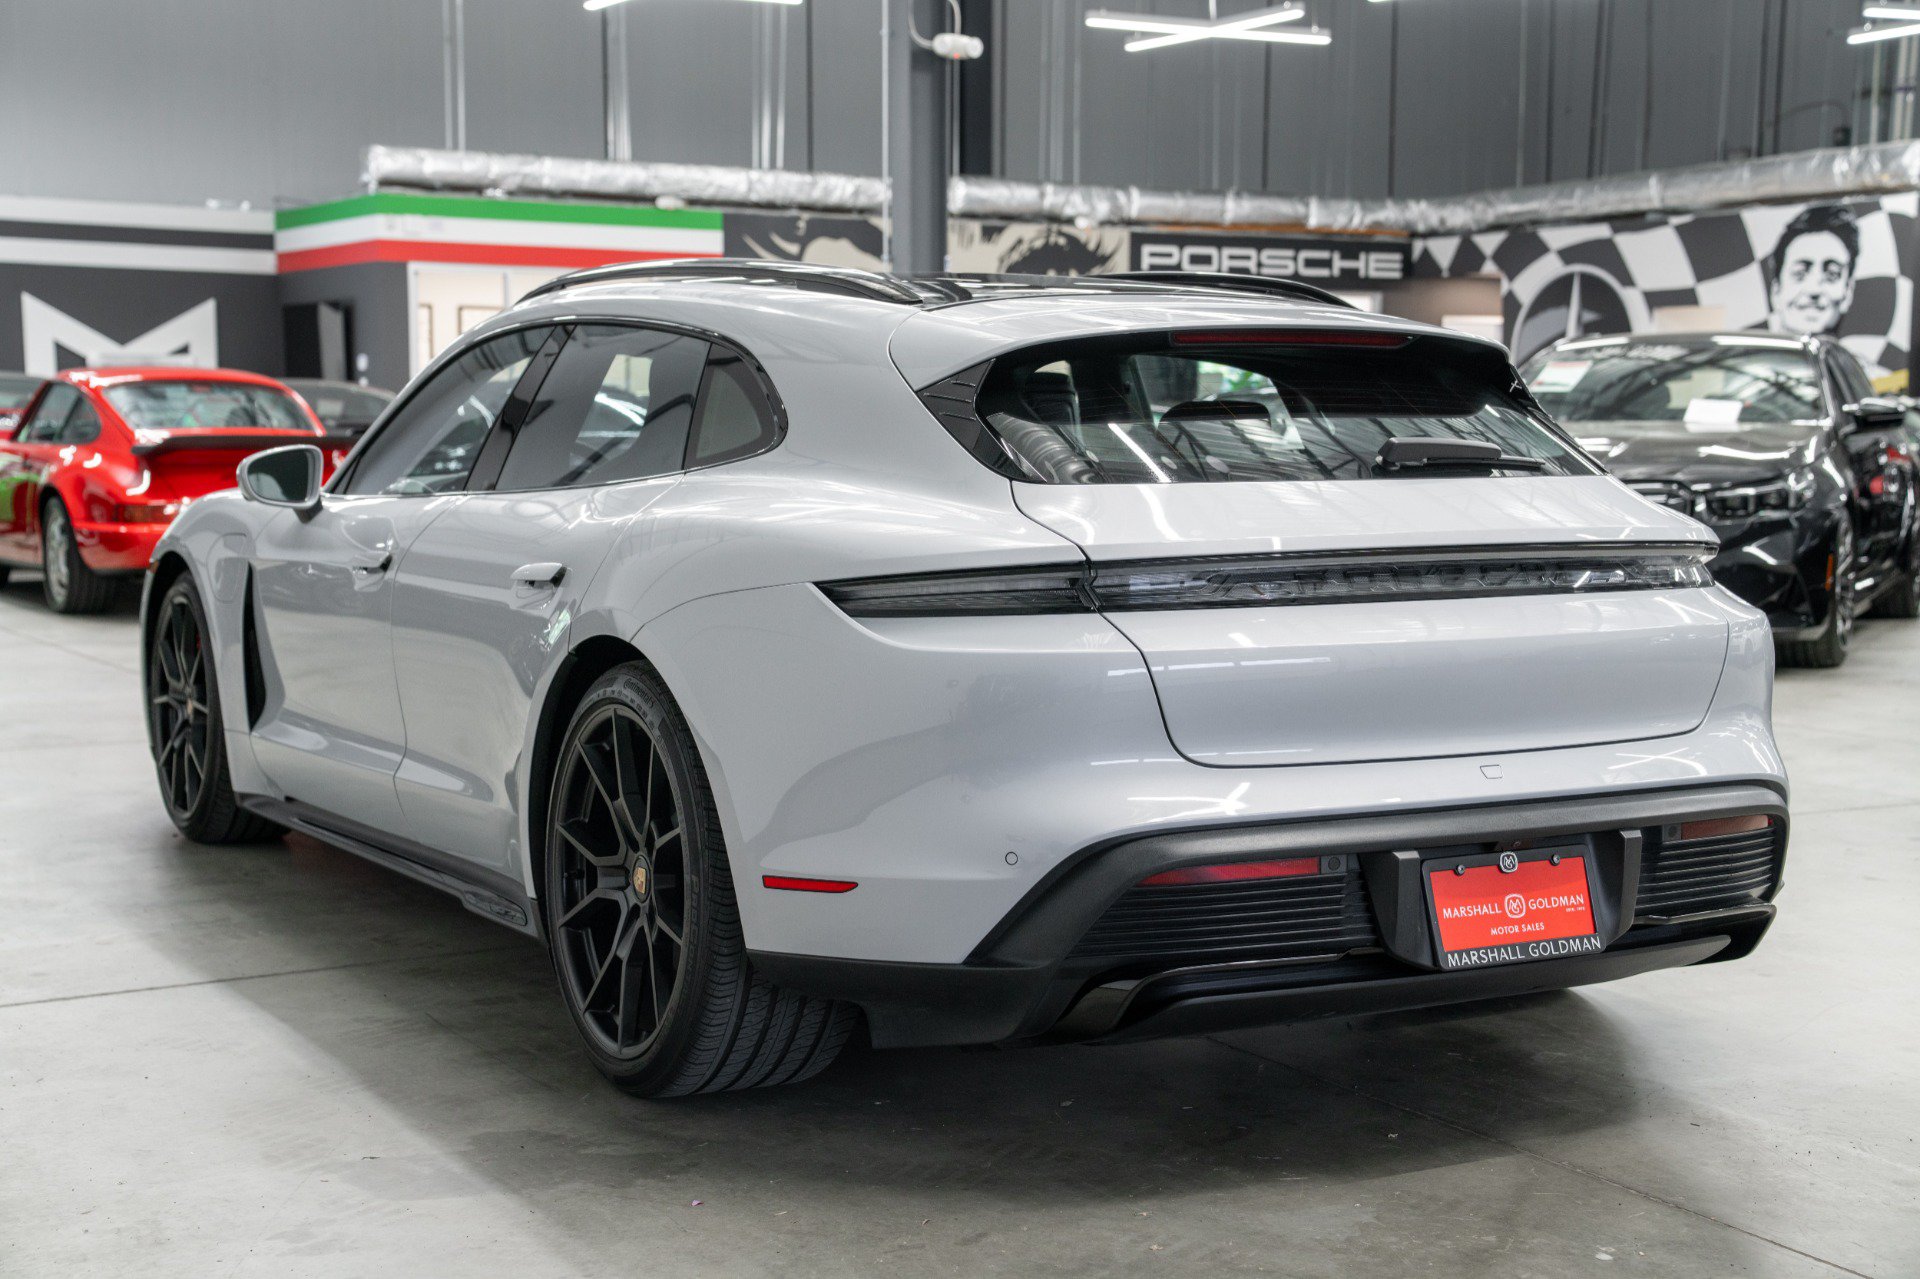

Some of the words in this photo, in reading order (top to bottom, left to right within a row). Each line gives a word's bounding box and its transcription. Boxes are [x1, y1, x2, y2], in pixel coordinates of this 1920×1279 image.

[1140, 242, 1404, 280] PORSCHE
[1442, 902, 1502, 919] MARSHALL
[1528, 893, 1585, 910] GOLDMAN
[1490, 924, 1520, 936] MOTOR
[1521, 921, 1545, 932] SALES
[1447, 945, 1525, 968] MARSHALL
[1528, 935, 1602, 958] GOLDMAN
